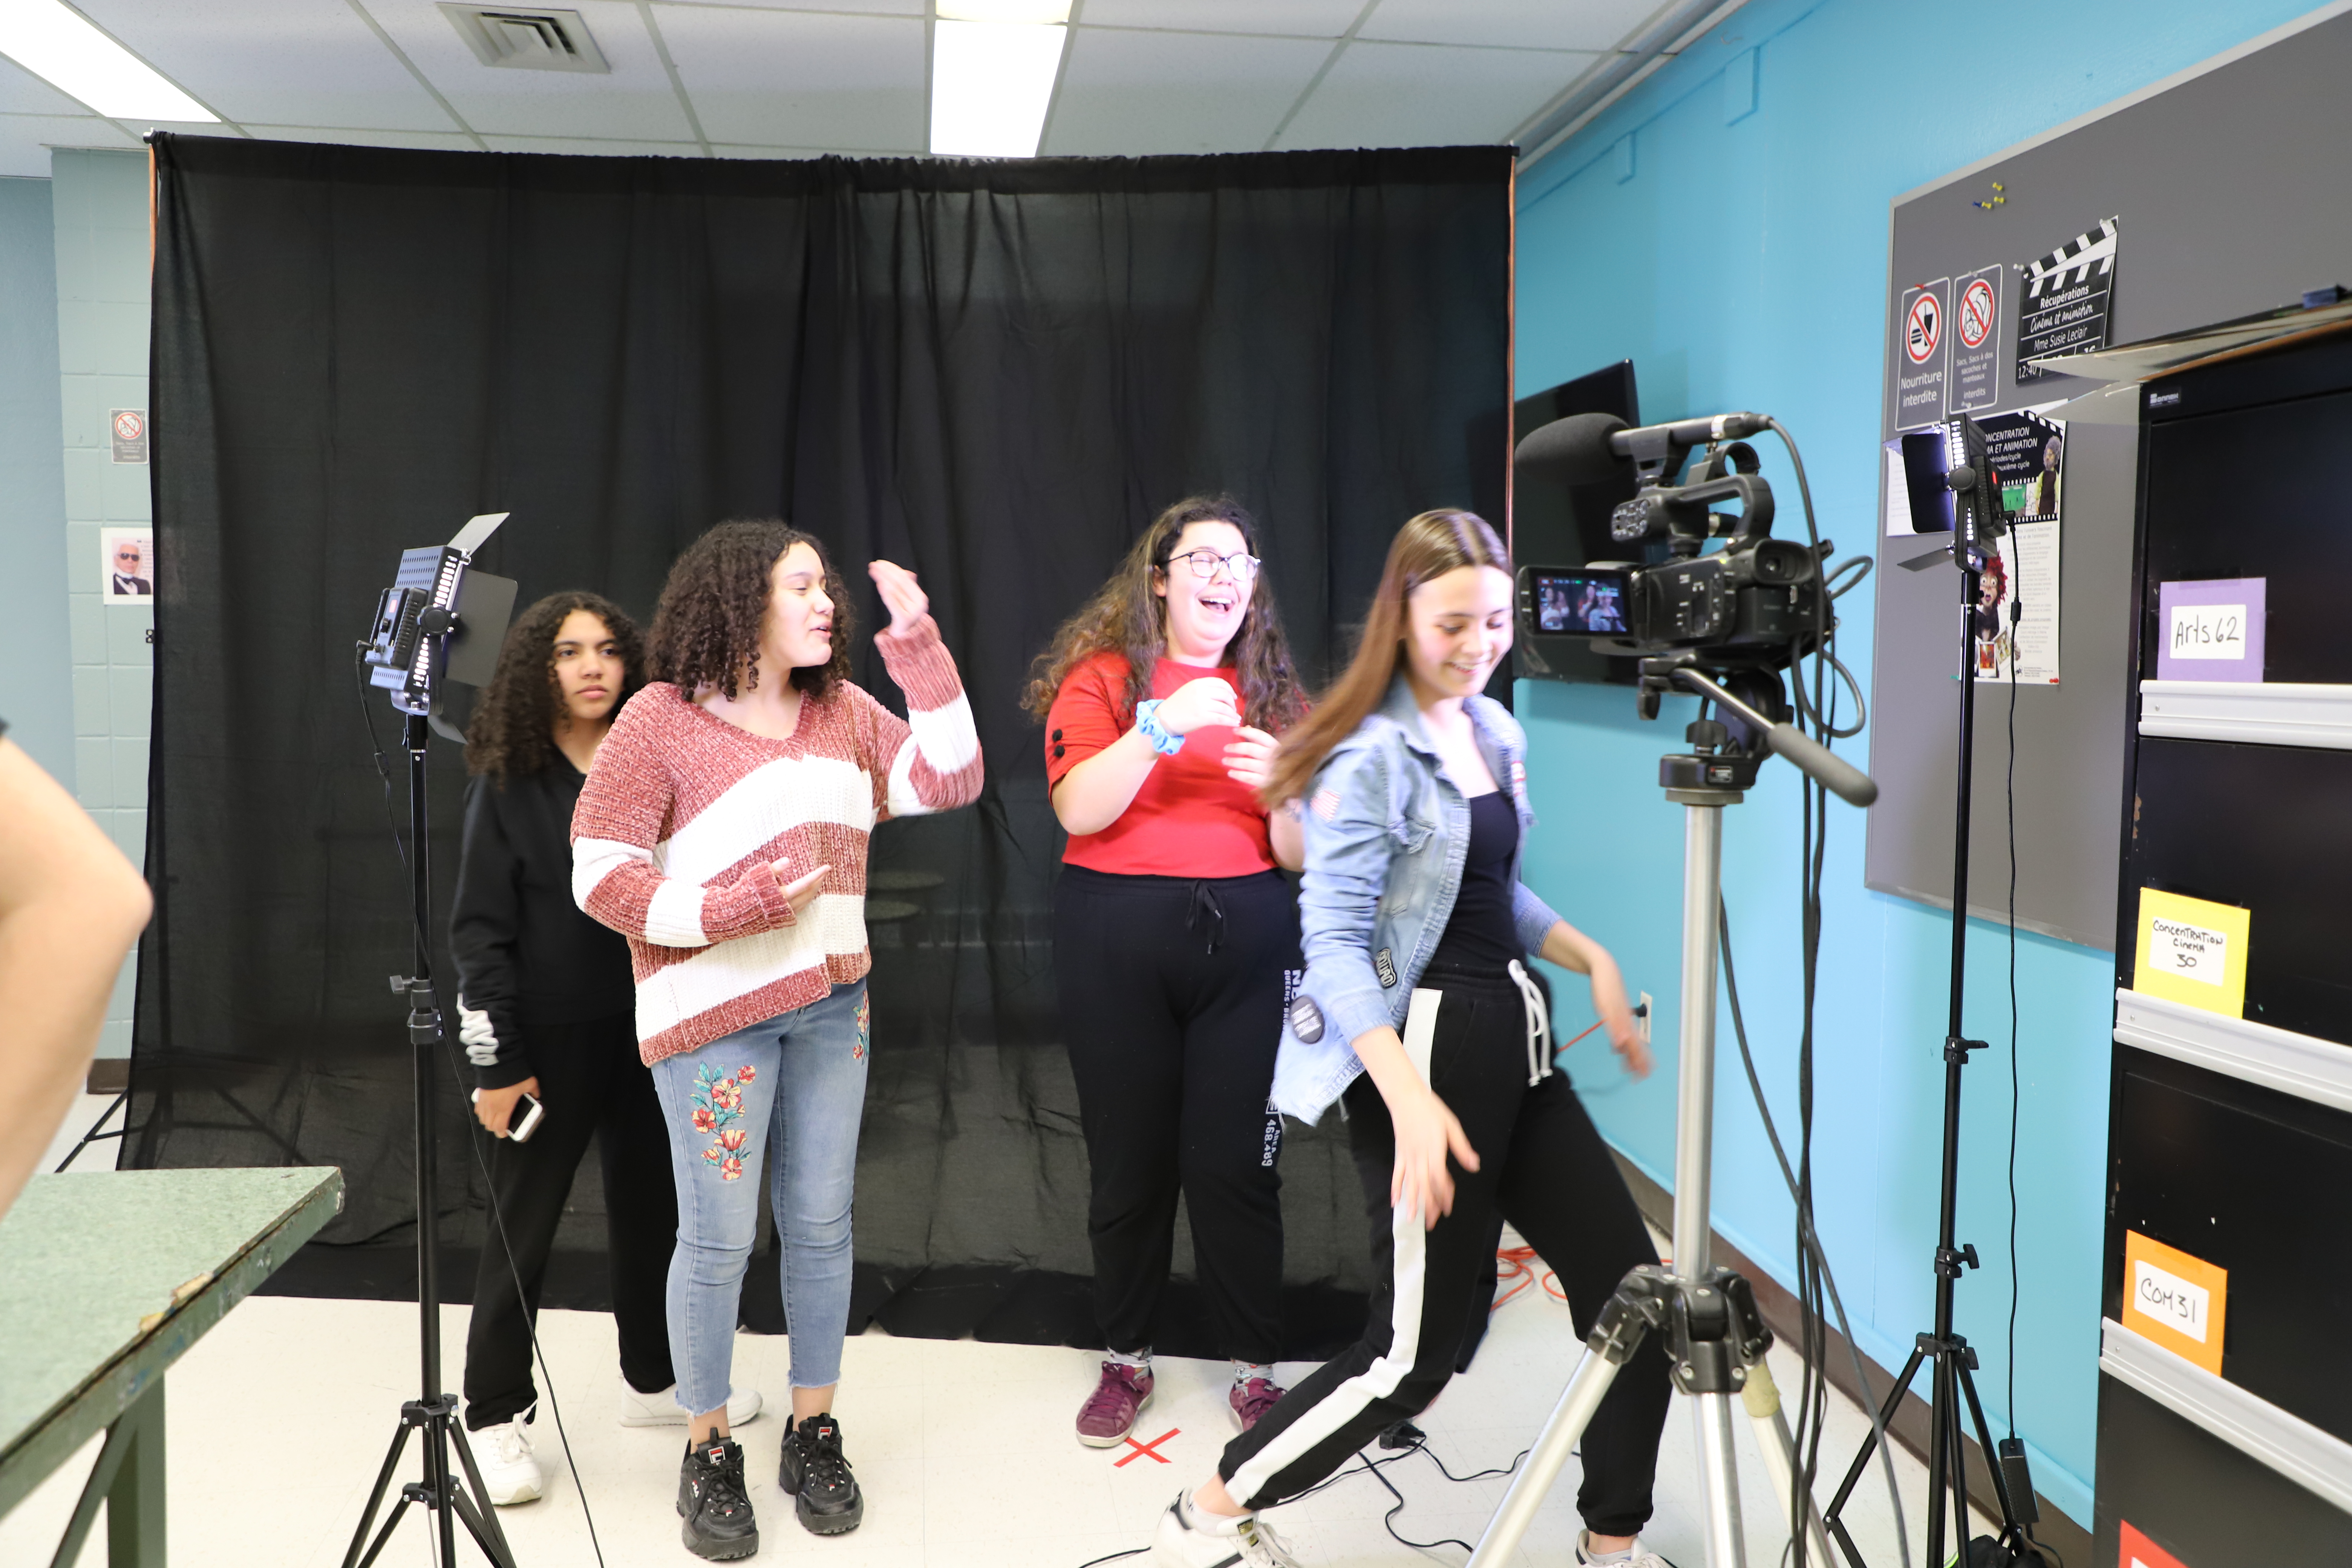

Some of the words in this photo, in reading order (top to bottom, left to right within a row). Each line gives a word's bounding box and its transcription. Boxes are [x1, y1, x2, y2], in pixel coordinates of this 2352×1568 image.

[2040, 285, 2089, 309] Récupérations
[2030, 312, 2053, 333] Cinéma
[2054, 310, 2061, 325] et
[2061, 300, 2093, 322] animation
[2034, 339, 2049, 352] Mme
[2050, 331, 2066, 348] Susie
[2067, 325, 2088, 341] Leclair
[1969, 355, 1979, 364] Sacs
[1961, 363, 1981, 375] sacoches
[2018, 364, 2037, 379] 12:40
[1901, 371, 1942, 390] Nourriture
[1963, 373, 1985, 383] manteaux
[1903, 390, 1937, 407] interdite
[1963, 387, 1986, 399] interdits
[1985, 426, 2029, 443] NCENTRATION
[1995, 443, 2002, 453] ET
[2003, 438, 2038, 452] ANIMATION
[1997, 462, 2017, 471] euxième
[2017, 460, 2030, 470] cycle
[2175, 614, 2210, 649] Arts
[2216, 616, 2240, 643] 62
[2177, 954, 2197, 968] 30
[2141, 1278, 2173, 1311] COM
[2177, 1294, 2196, 1324] 31
